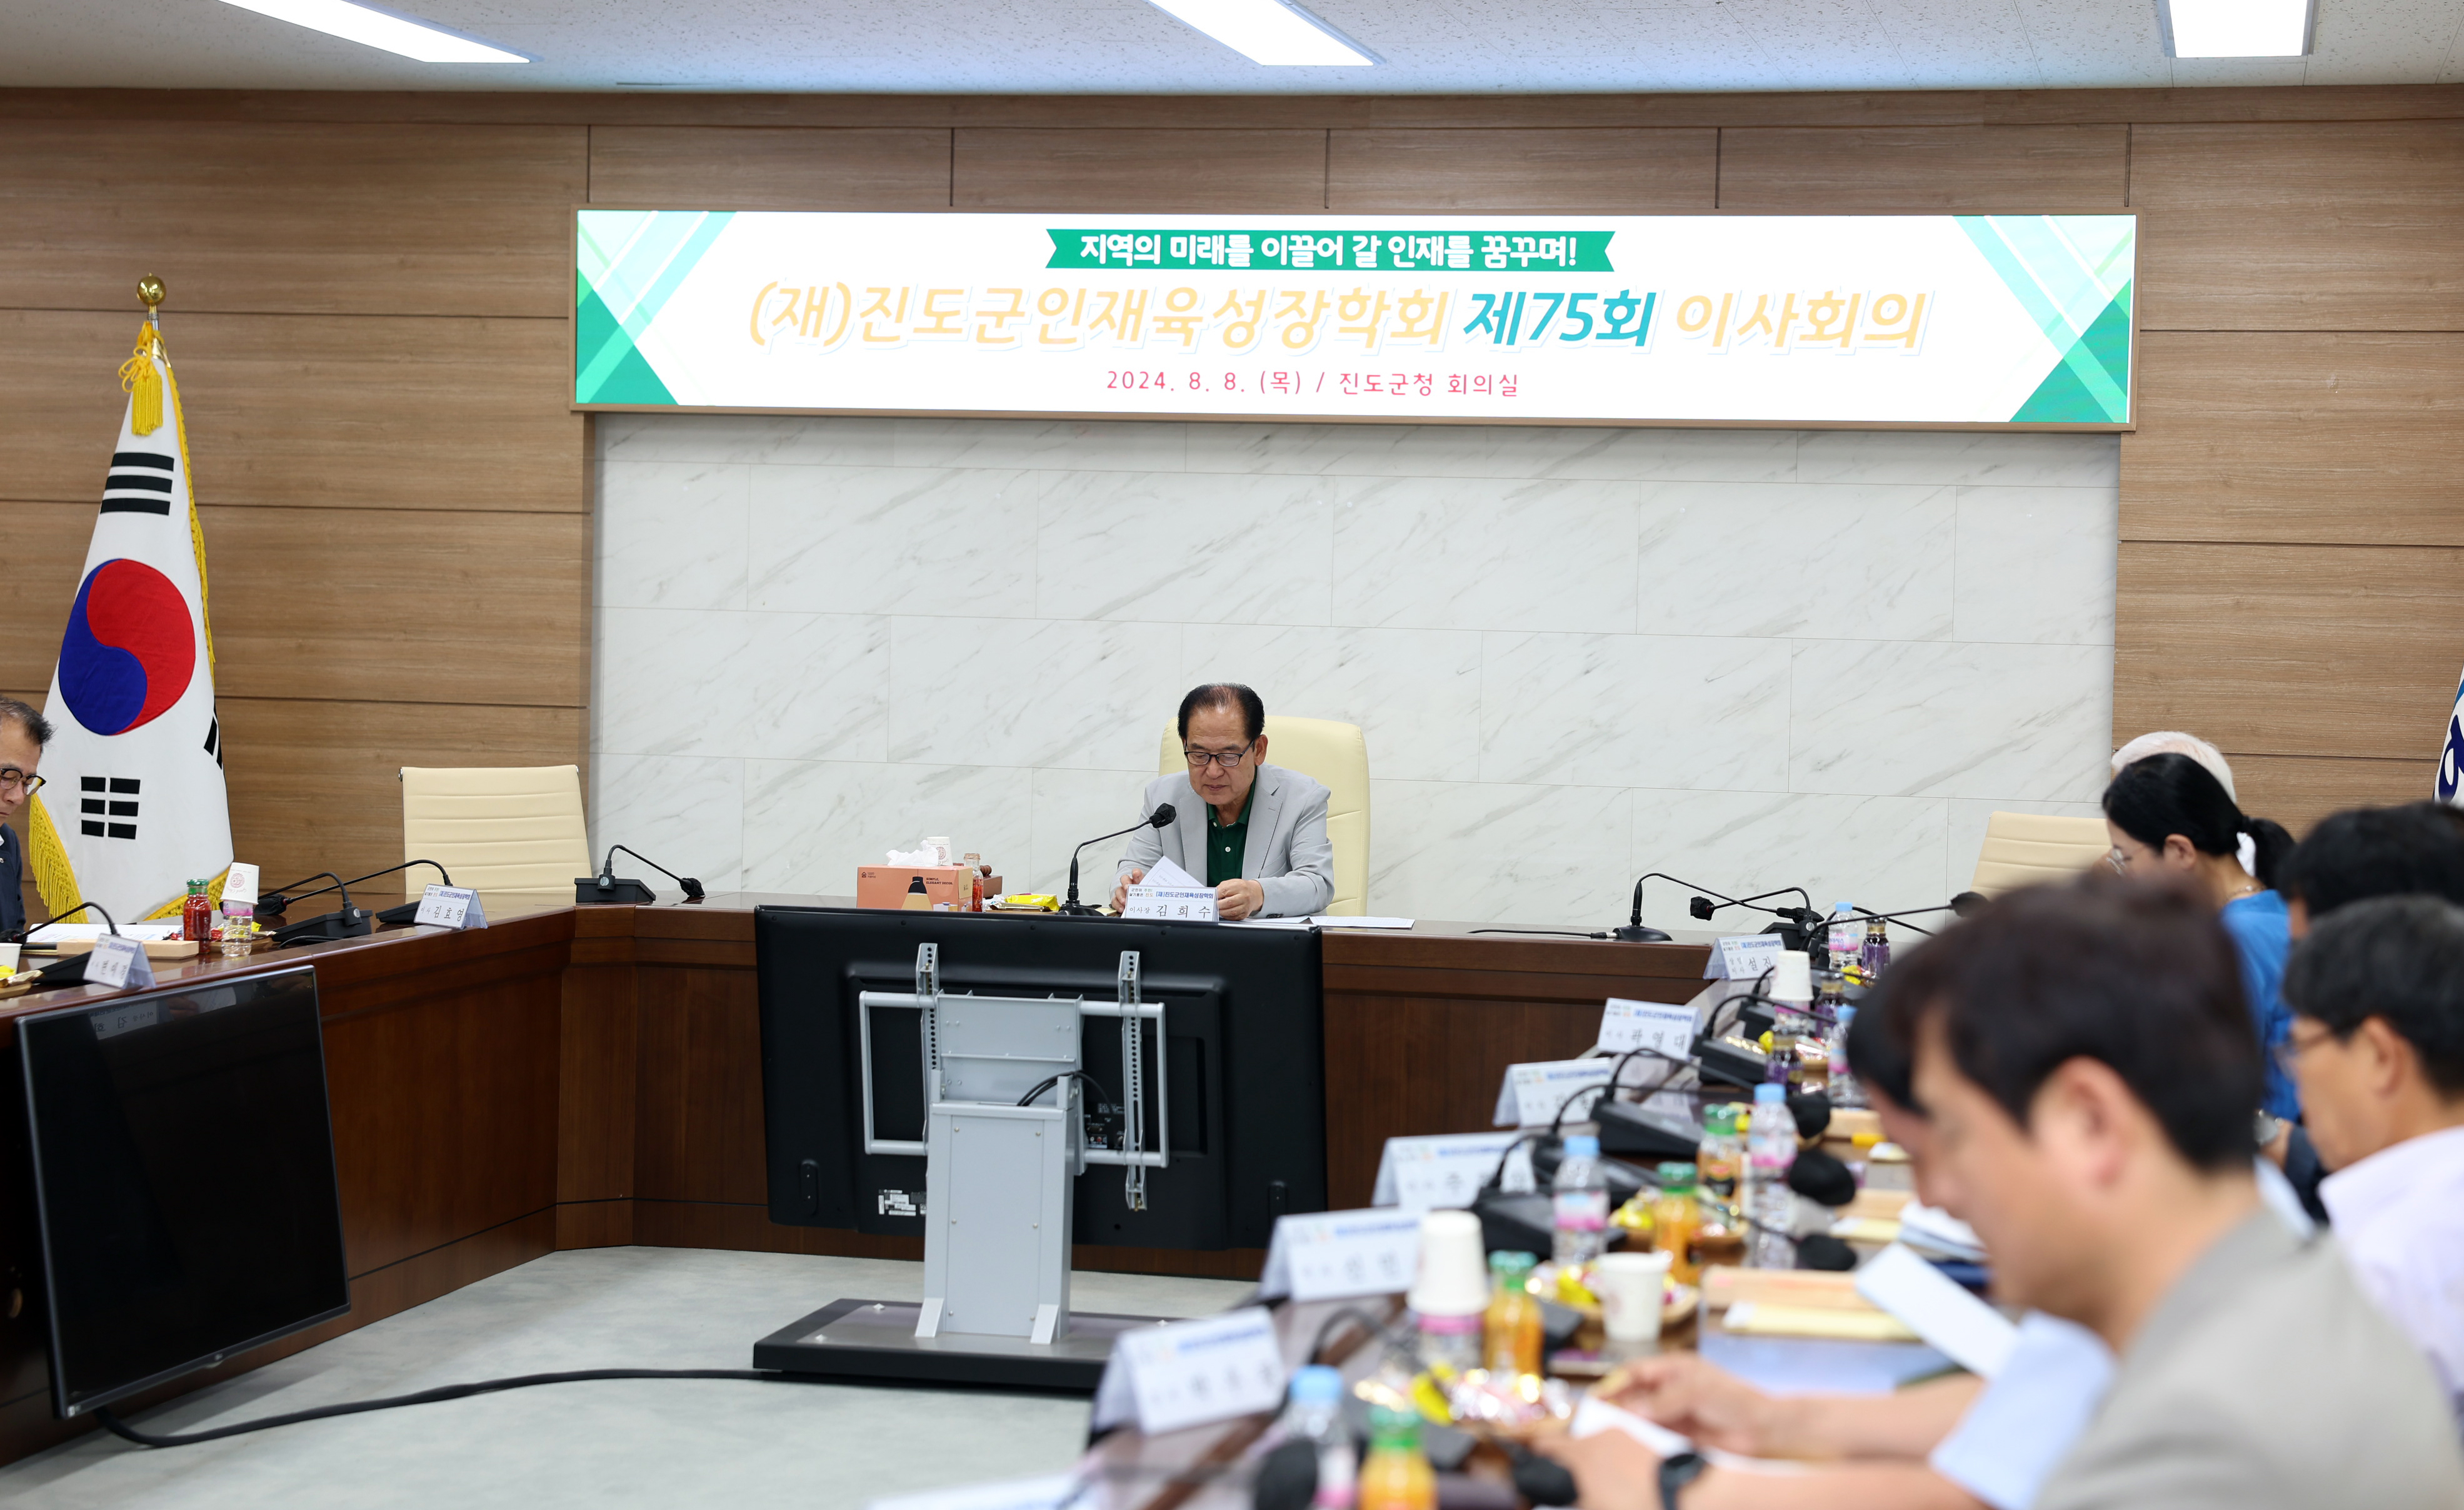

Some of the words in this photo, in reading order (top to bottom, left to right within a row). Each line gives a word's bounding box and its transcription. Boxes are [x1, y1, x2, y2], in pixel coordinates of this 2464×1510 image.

[1081, 234, 1161, 266] 지역의
[1170, 234, 1255, 268] 미래를
[1261, 235, 1343, 268] 이끌어
[1353, 235, 1382, 268] 갈
[1388, 236, 1474, 268] 인재를
[1481, 236, 1576, 269] 꿈꾸며!
[750, 281, 1449, 349] (재)진도군인재육성장학회
[1464, 289, 1656, 348] 제75회
[1676, 291, 1926, 348] 이사회의
[1107, 371, 1174, 391] 2024.
[1189, 371, 1209, 392] 8.
[1224, 372, 1245, 392] 8.
[1260, 371, 1301, 394] (목)
[1340, 372, 1432, 396] 진도군청
[1448, 374, 1518, 397] 회의실
[1129, 906, 1151, 914] 이사장
